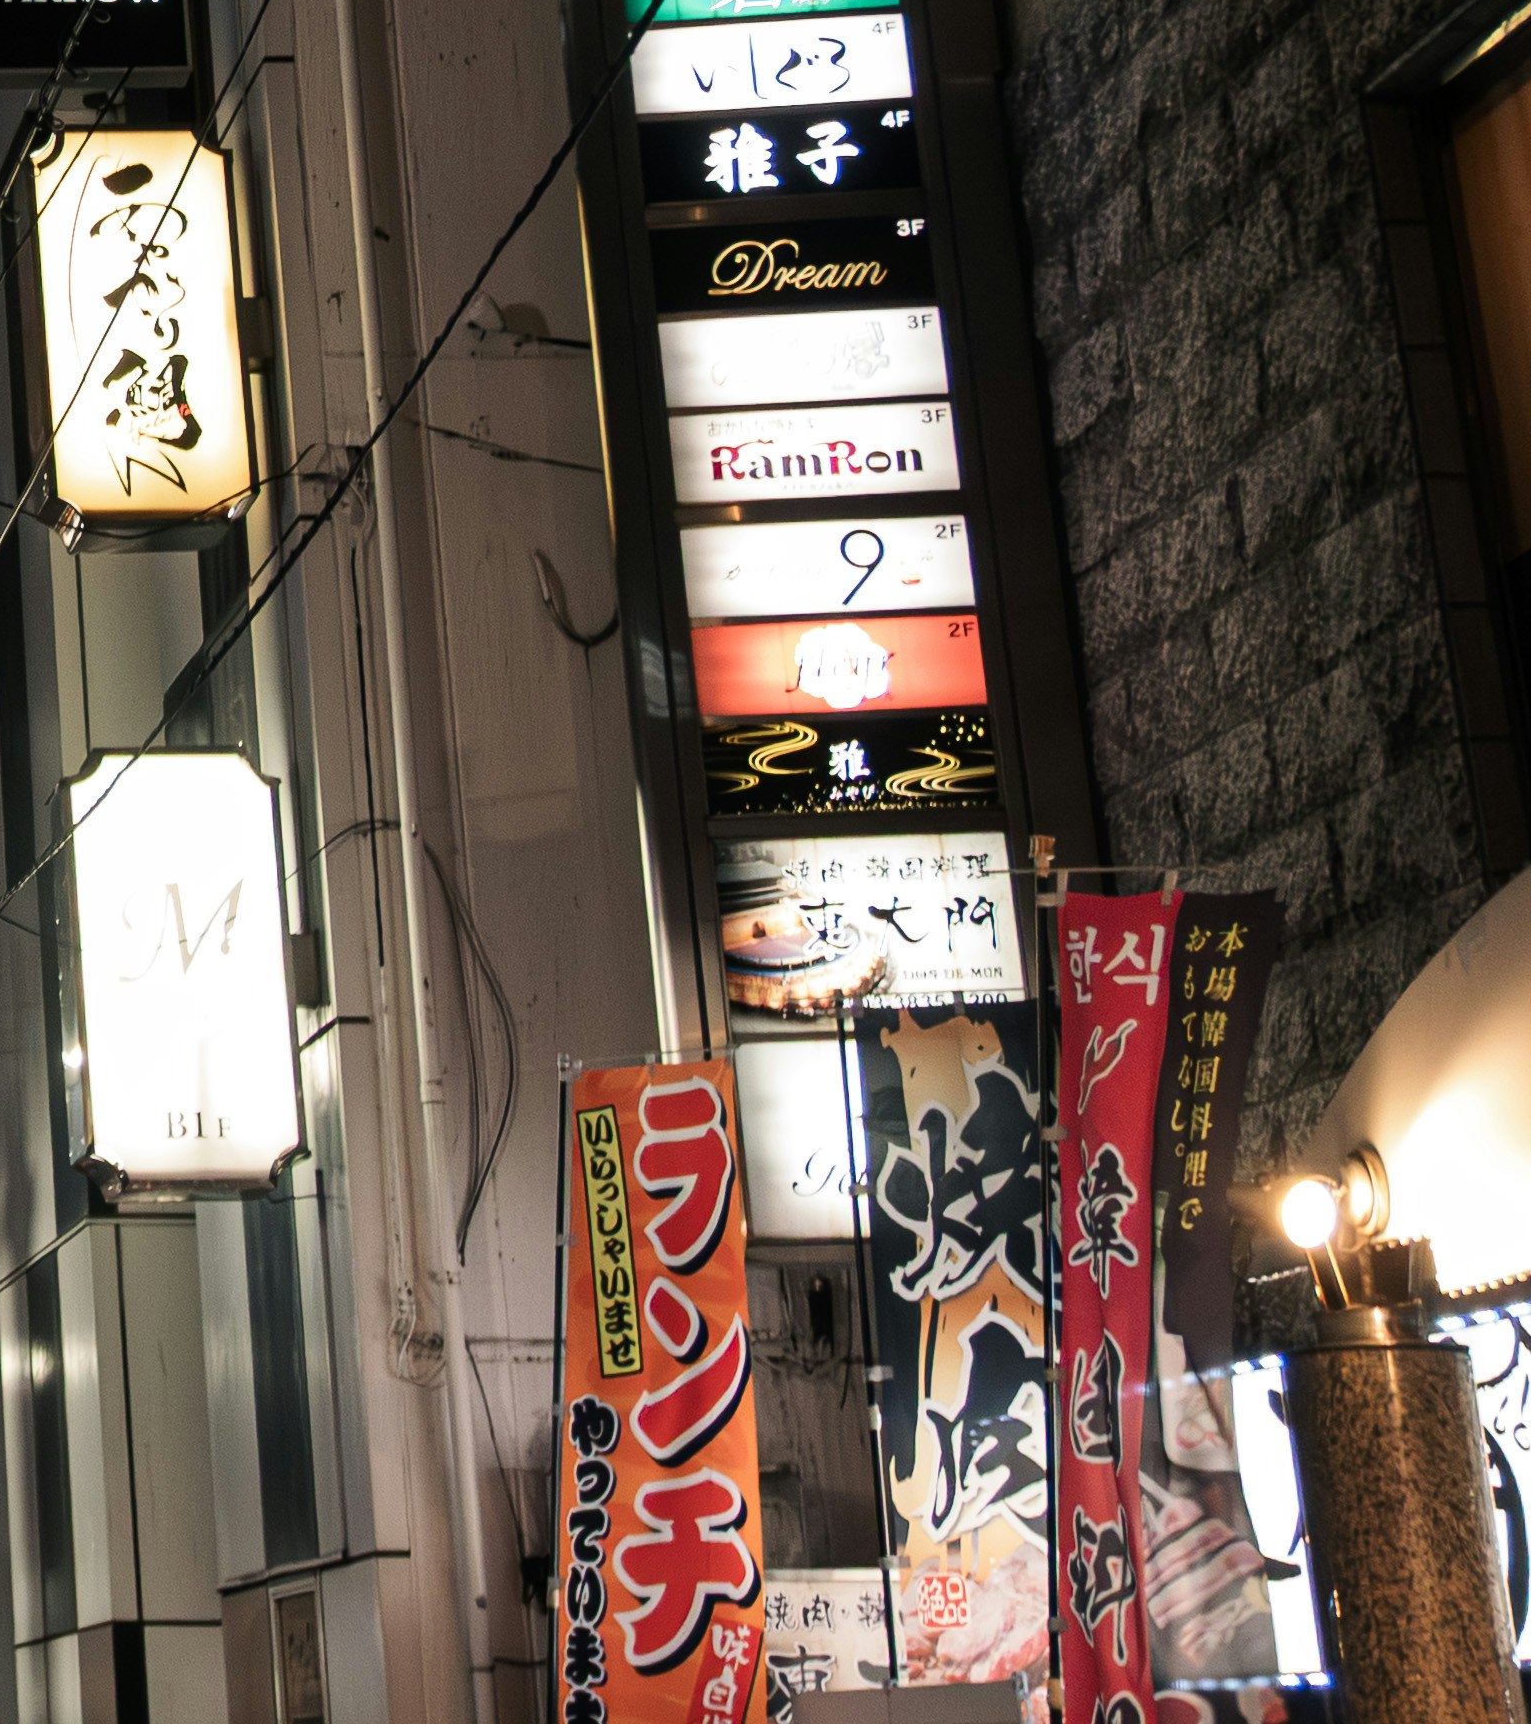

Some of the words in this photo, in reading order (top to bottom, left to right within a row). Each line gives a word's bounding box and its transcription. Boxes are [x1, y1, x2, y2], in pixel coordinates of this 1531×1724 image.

[871, 20, 899, 36] 4F
[880, 109, 911, 128] 4F
[703, 121, 861, 193] 雅子
[896, 218, 926, 237] 3F
[707, 238, 888, 296] Dream
[906, 313, 934, 329] 3F
[921, 407, 948, 425] 3F
[710, 439, 924, 482] RamRon
[934, 523, 962, 539] 2F
[947, 622, 975, 638] 2F
[828, 739, 871, 781] 雅
[799, 895, 998, 962] 東大門
[1065, 923, 1166, 1006] 한식
[583, 1113, 636, 1369] いらっしゃいませ
[613, 1075, 762, 1676] ランチ
[692, 1624, 752, 1724] 味自
